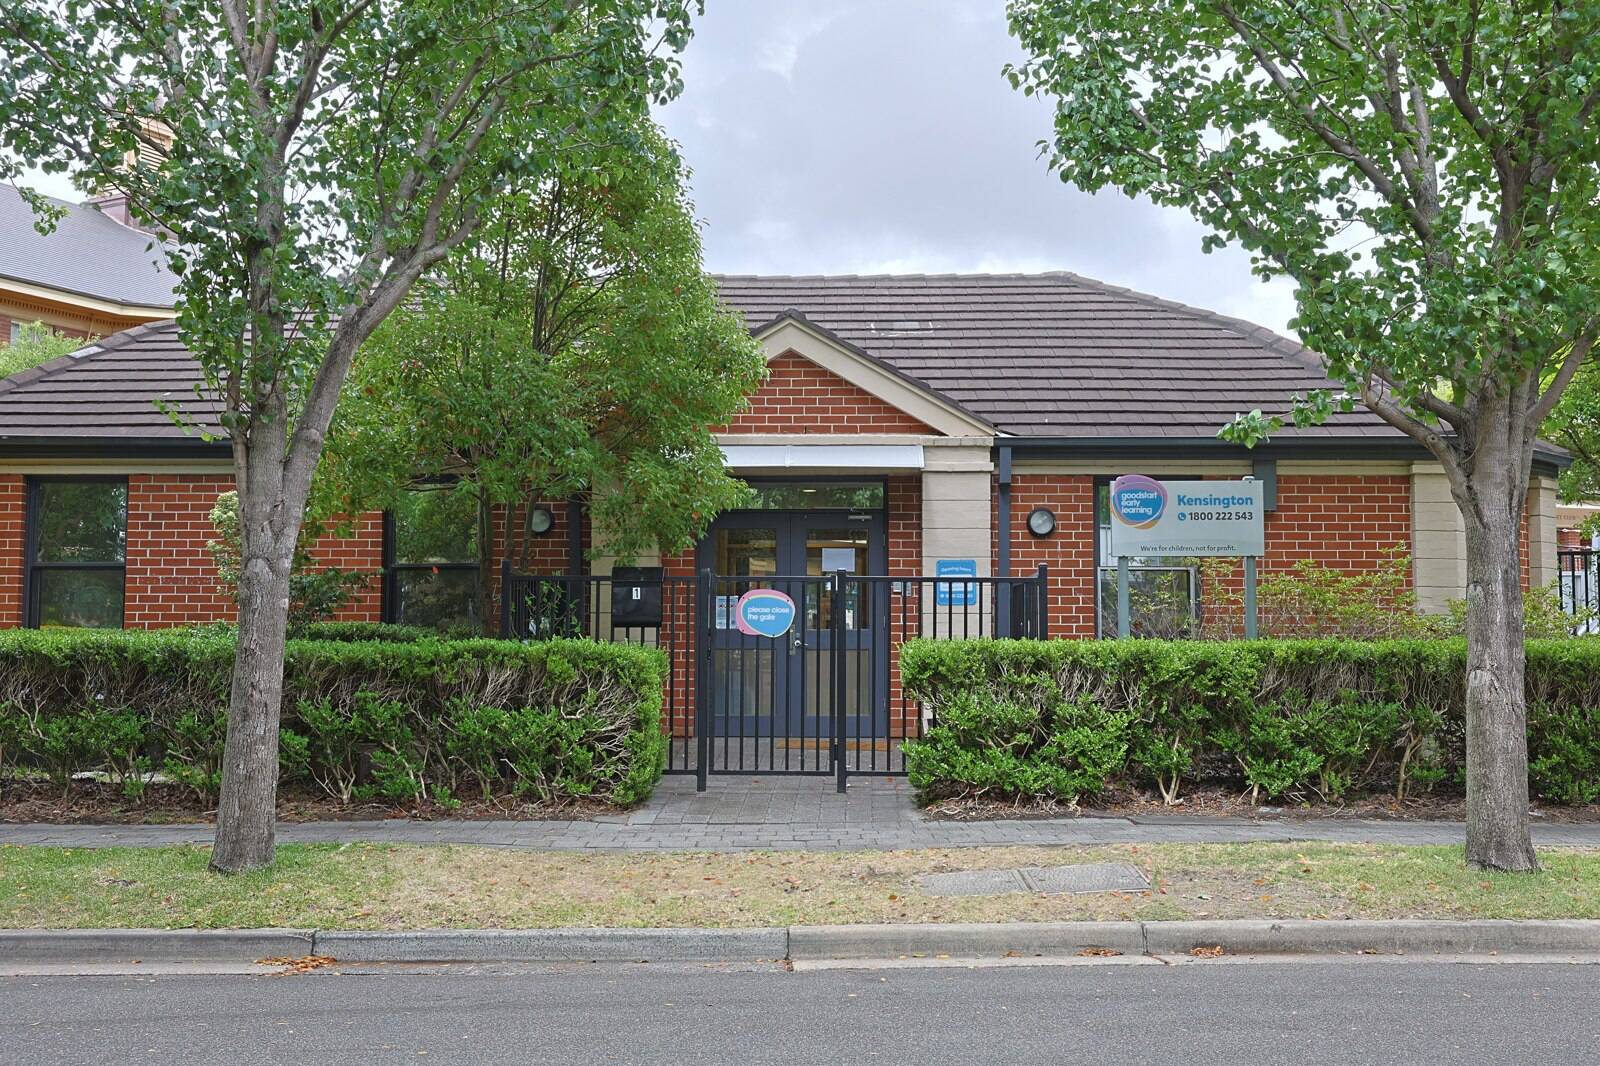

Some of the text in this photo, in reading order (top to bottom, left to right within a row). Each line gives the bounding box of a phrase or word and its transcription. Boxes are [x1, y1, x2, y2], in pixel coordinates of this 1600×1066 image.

[1121, 492, 1158, 500] goodstart
[1178, 494, 1253, 508] Kensington
[1121, 506, 1152, 515] learning
[1189, 512, 1253, 520] 1800 222 543
[1216, 545, 1236, 553] profit.
[748, 606, 770, 614] please
